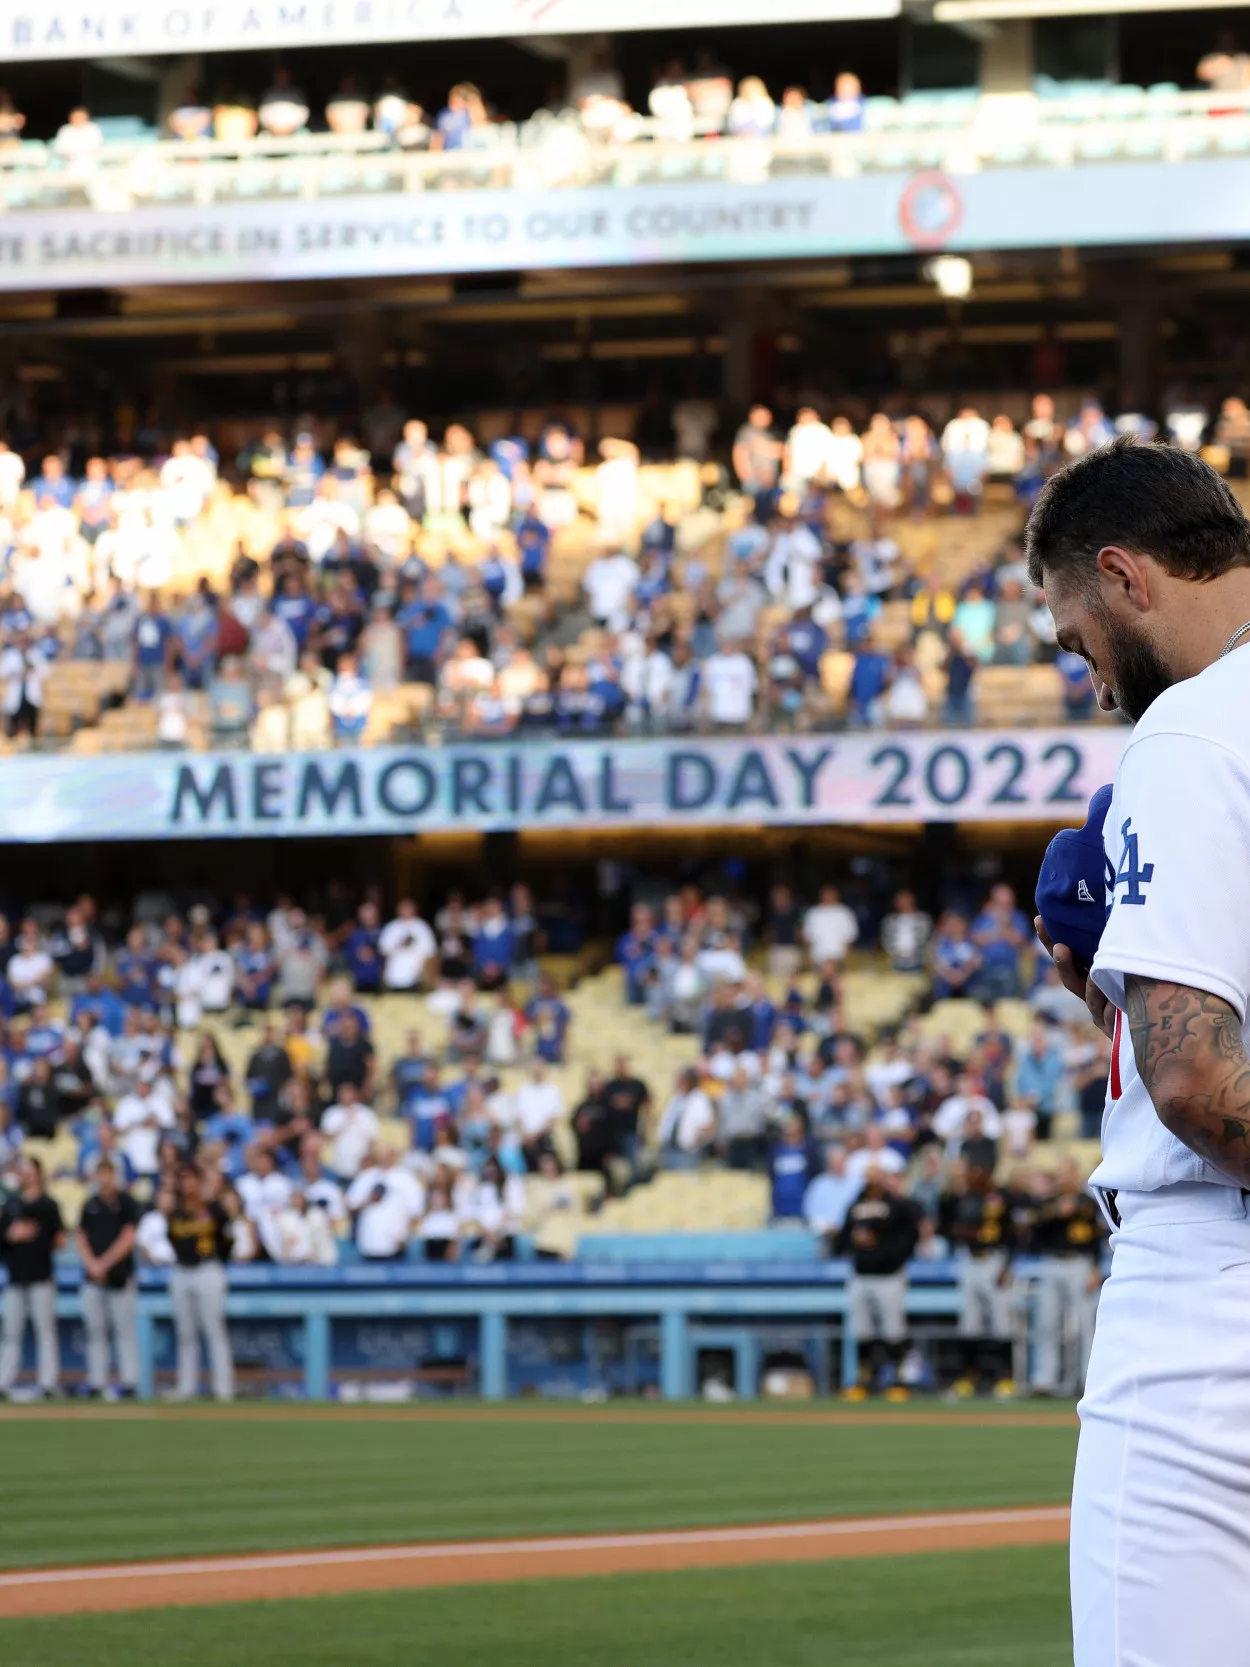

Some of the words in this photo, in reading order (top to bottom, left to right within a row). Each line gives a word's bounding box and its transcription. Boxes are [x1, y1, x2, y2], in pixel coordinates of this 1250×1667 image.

[12, 15, 142, 46] BANK
[40, 223, 224, 262] SACRIFICE
[237, 224, 281, 253] IN
[297, 215, 445, 249] SERVICE
[463, 211, 510, 241] TO
[524, 206, 610, 240] OUR
[624, 199, 817, 239] COUNTRY
[172, 755, 635, 821] MEMORIAL
[664, 746, 834, 811] DAY
[869, 742, 1085, 807] 2022
